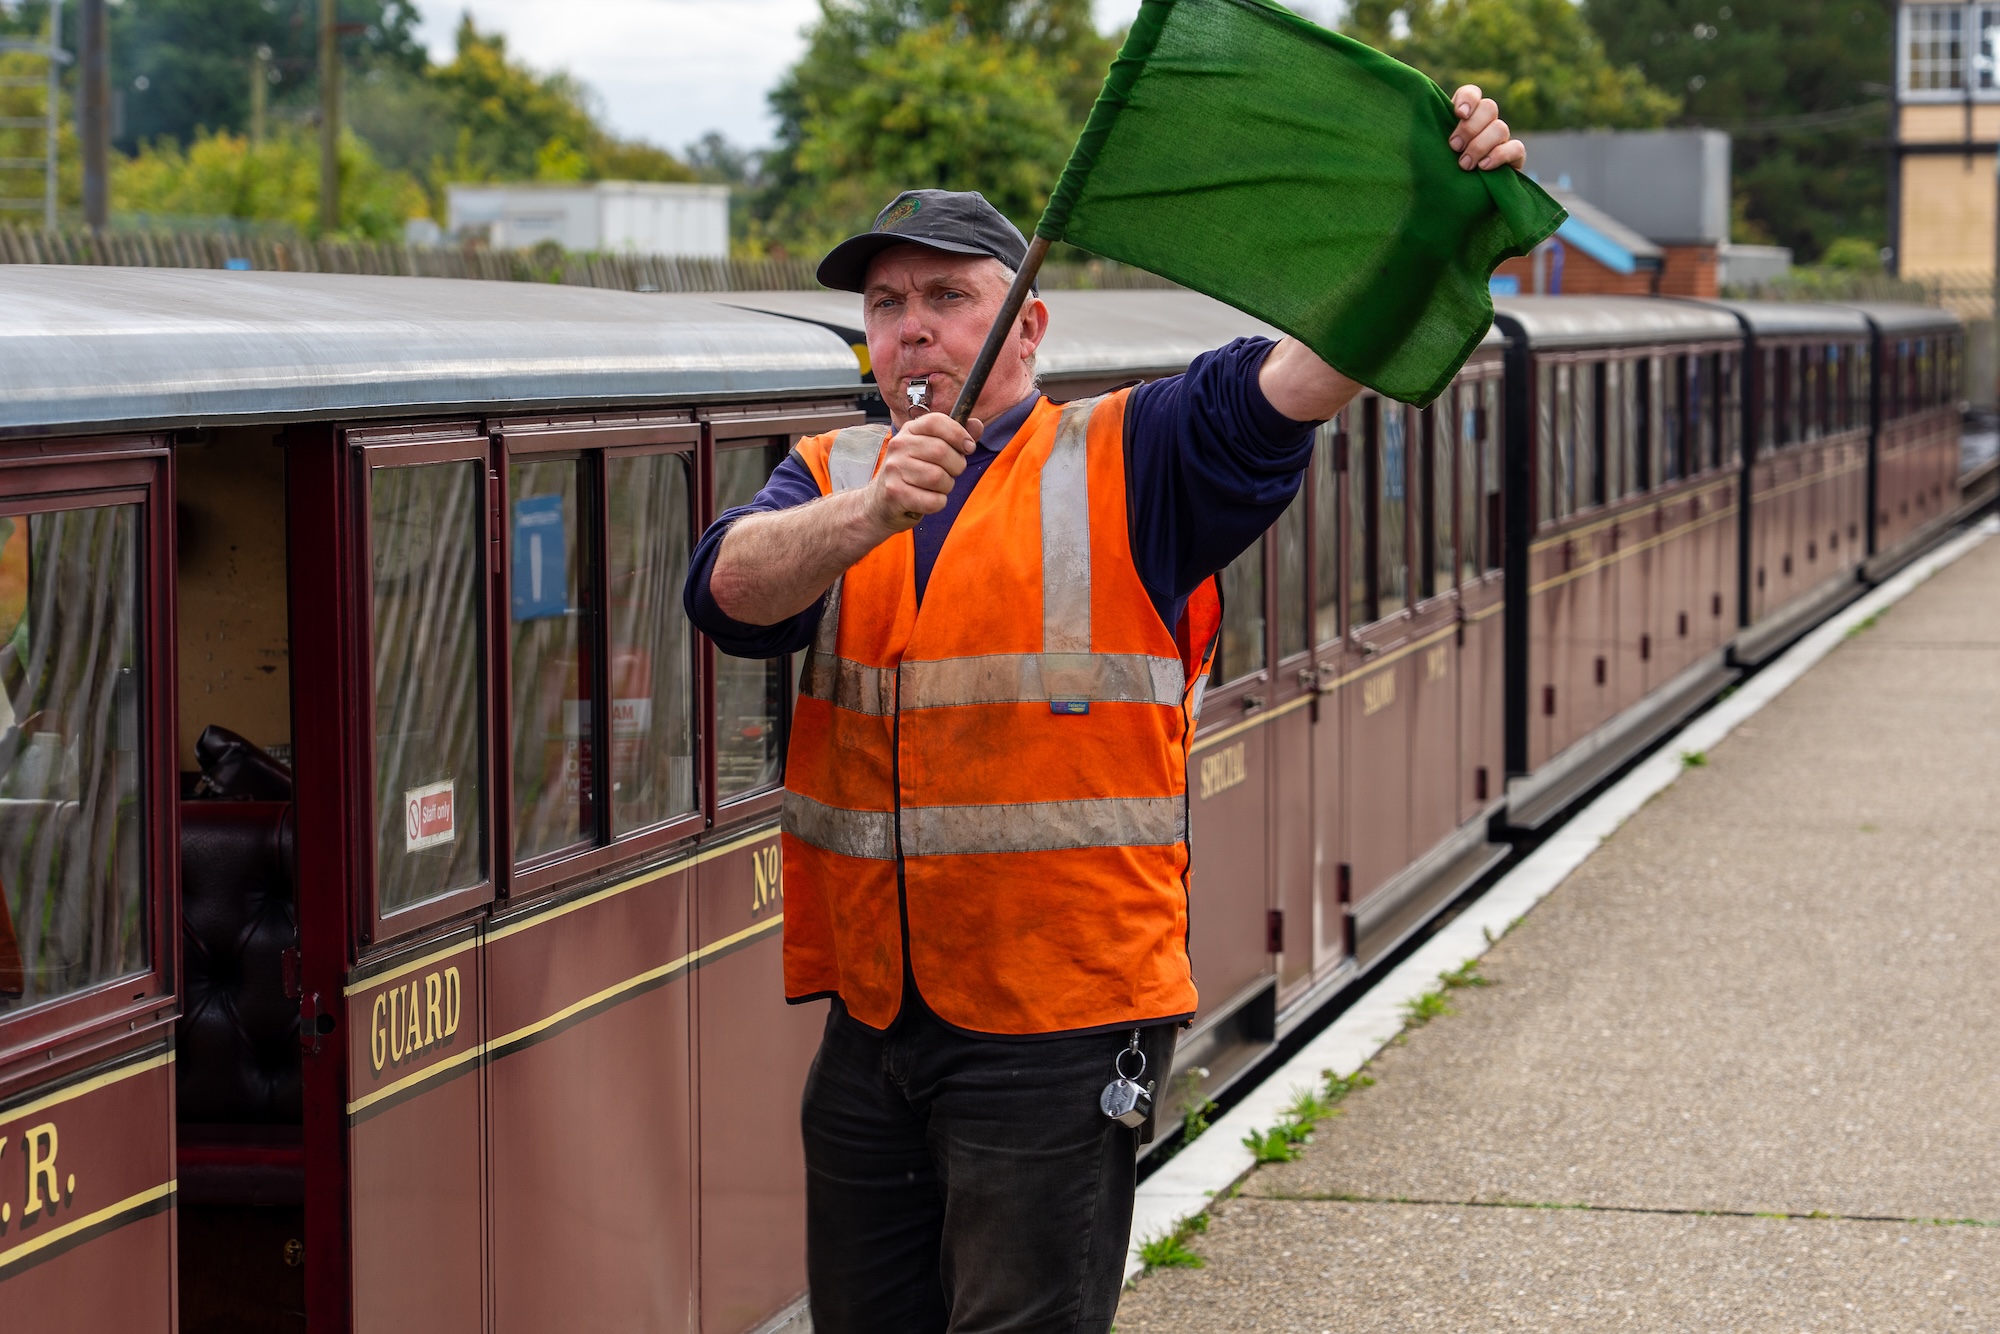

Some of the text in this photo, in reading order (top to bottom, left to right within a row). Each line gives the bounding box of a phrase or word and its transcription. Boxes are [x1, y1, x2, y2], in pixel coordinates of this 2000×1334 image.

[1200, 741, 1246, 800] SPECIAL
[422, 801, 450, 824] Staff only
[372, 966, 461, 1071] GUARD
